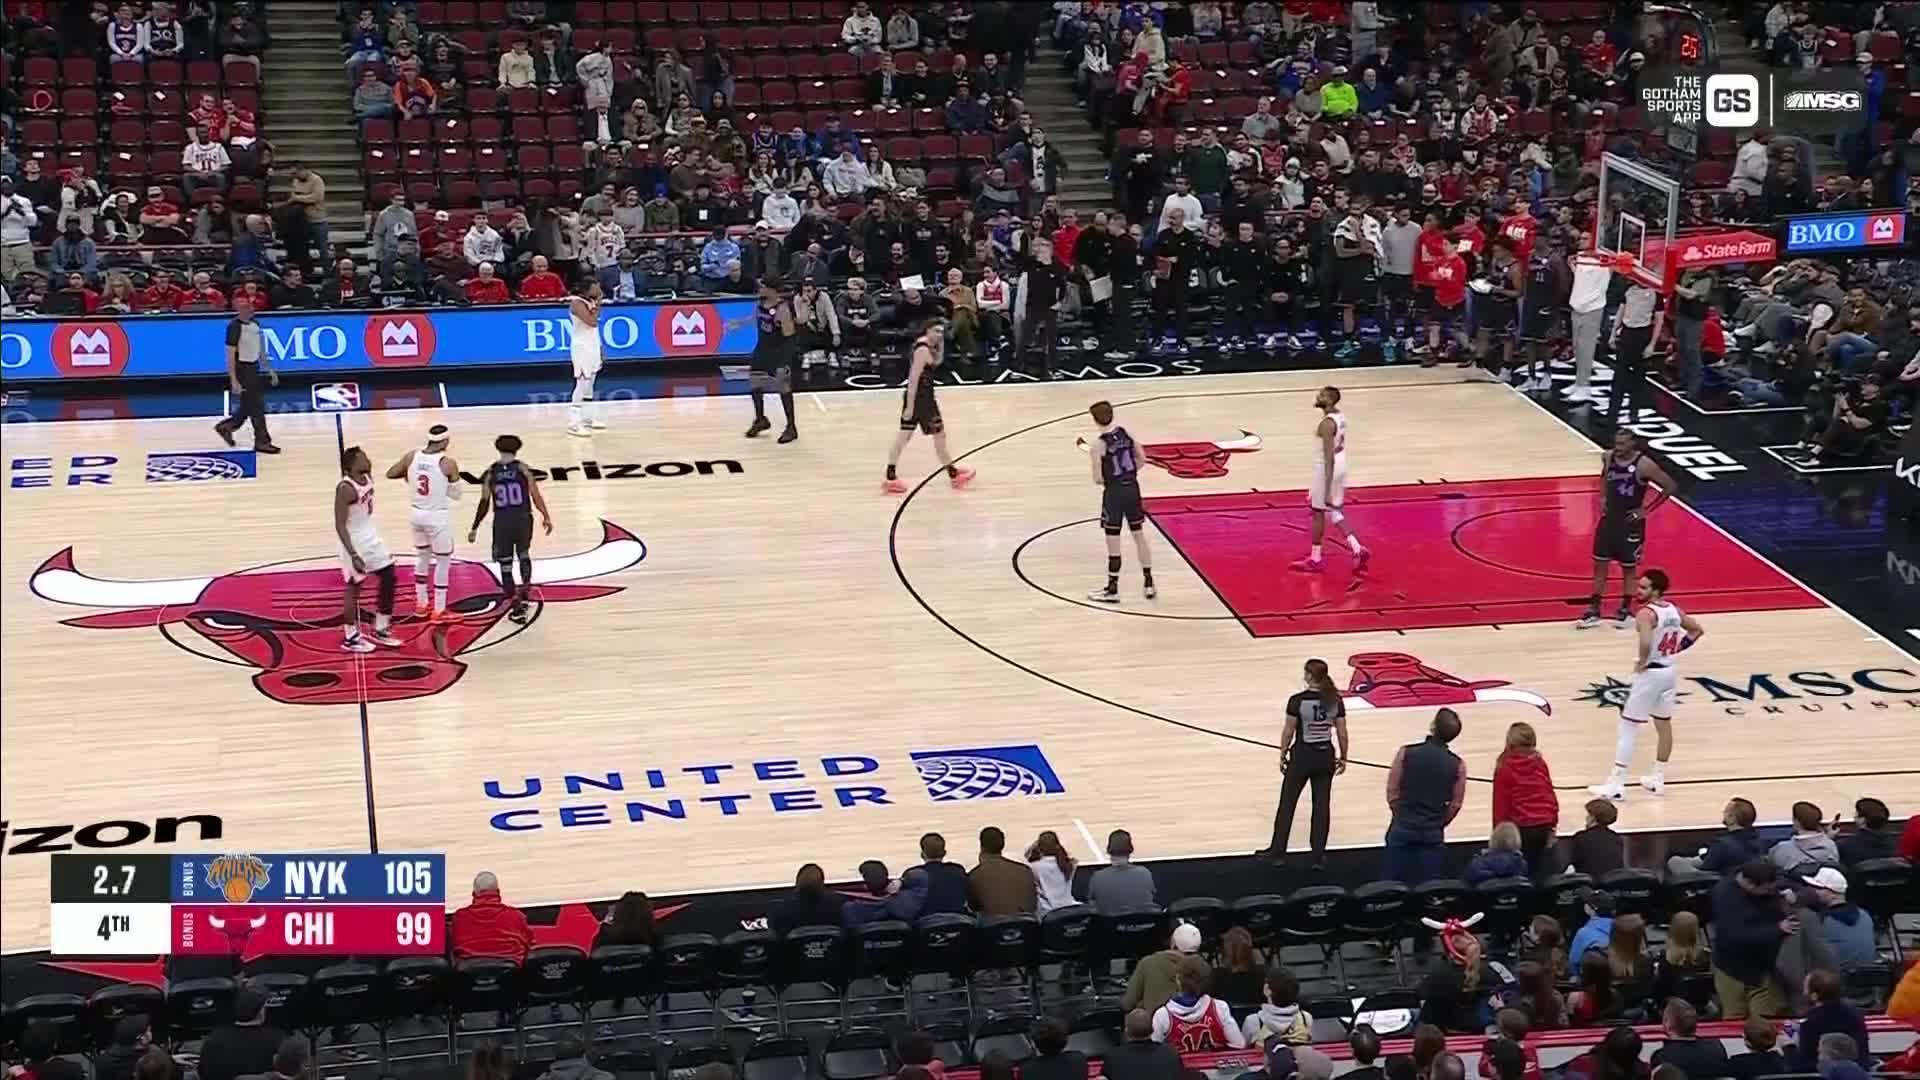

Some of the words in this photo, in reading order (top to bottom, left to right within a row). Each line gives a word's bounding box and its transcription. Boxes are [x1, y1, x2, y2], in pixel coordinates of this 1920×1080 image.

[1681, 34, 1698, 58] 25
[1789, 222, 1855, 245] BMO
[263, 325, 347, 363] MO
[845, 359, 1204, 389] CLAMOS
[417, 474, 430, 496] 3
[495, 482, 523, 508] 30
[1657, 631, 1682, 657] 44
[1691, 668, 1920, 703] MSC
[484, 755, 880, 799] UNITED
[490, 786, 895, 832] CENTER
